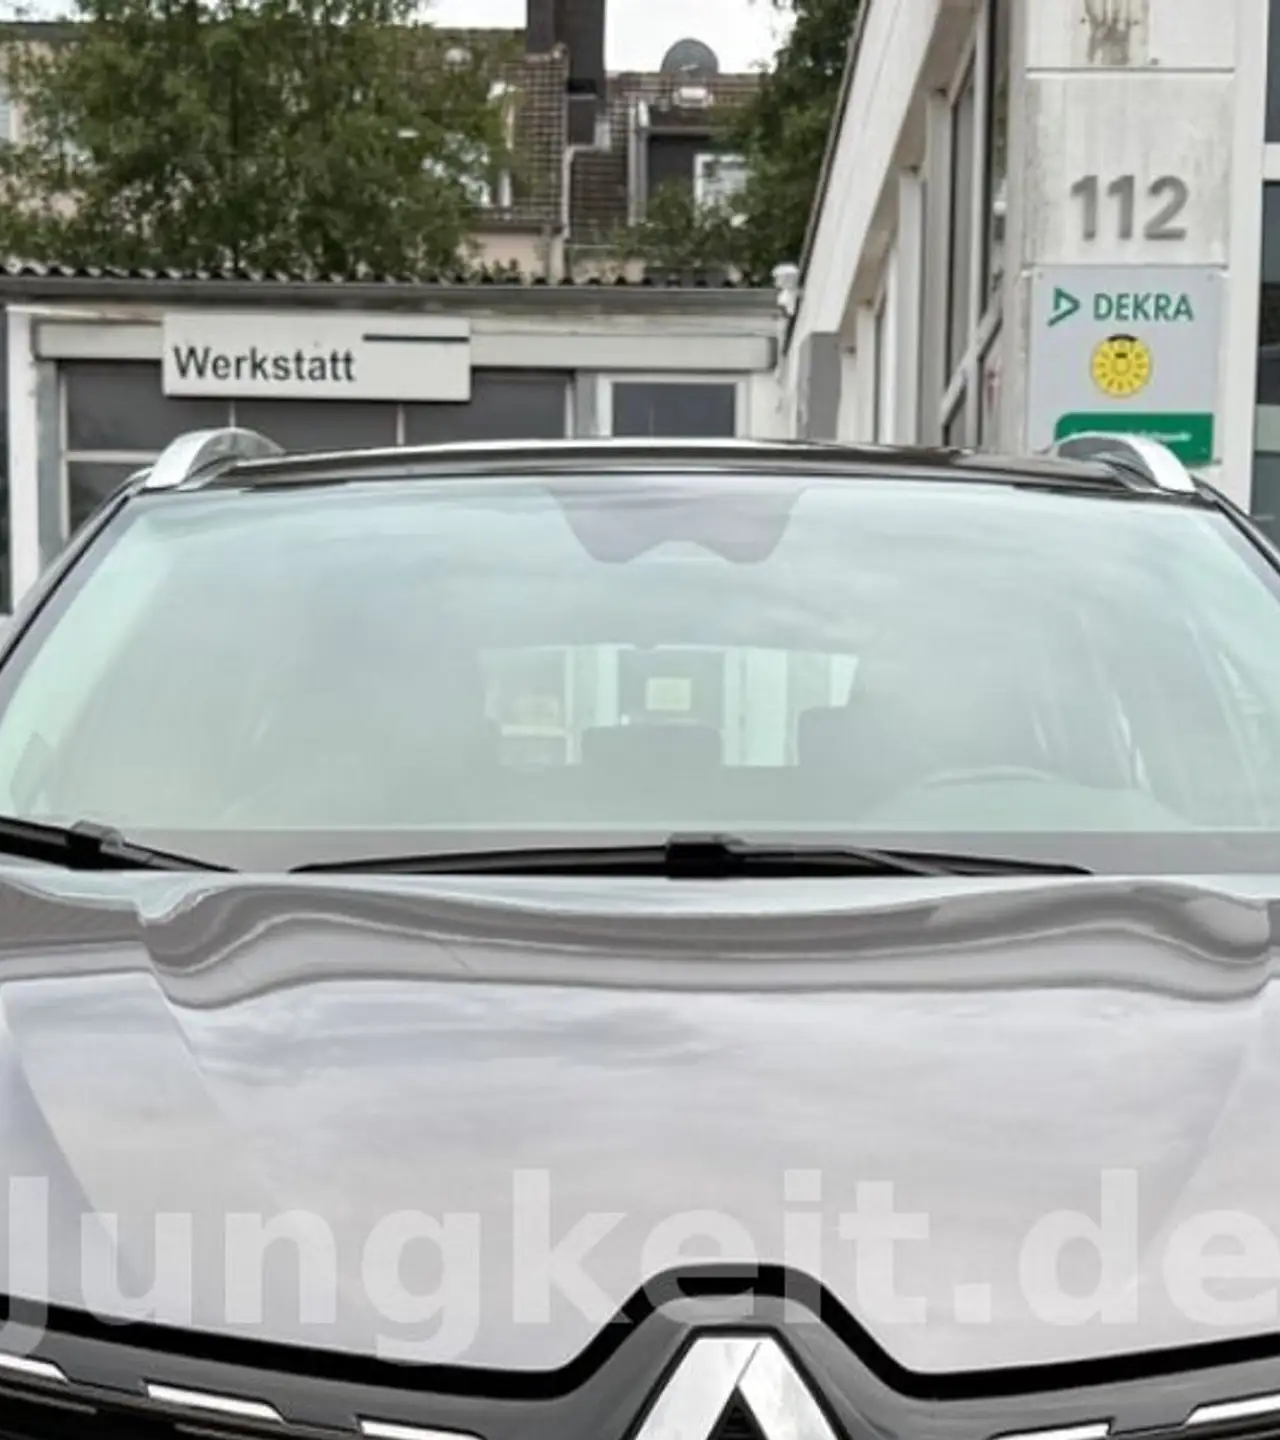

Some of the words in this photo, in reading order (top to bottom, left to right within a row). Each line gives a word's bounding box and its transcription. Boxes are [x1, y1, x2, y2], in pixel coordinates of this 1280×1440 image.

[1070, 174, 1190, 241] 112
[1093, 292, 1195, 323] DEKRA
[172, 344, 357, 384] Werkstatt
